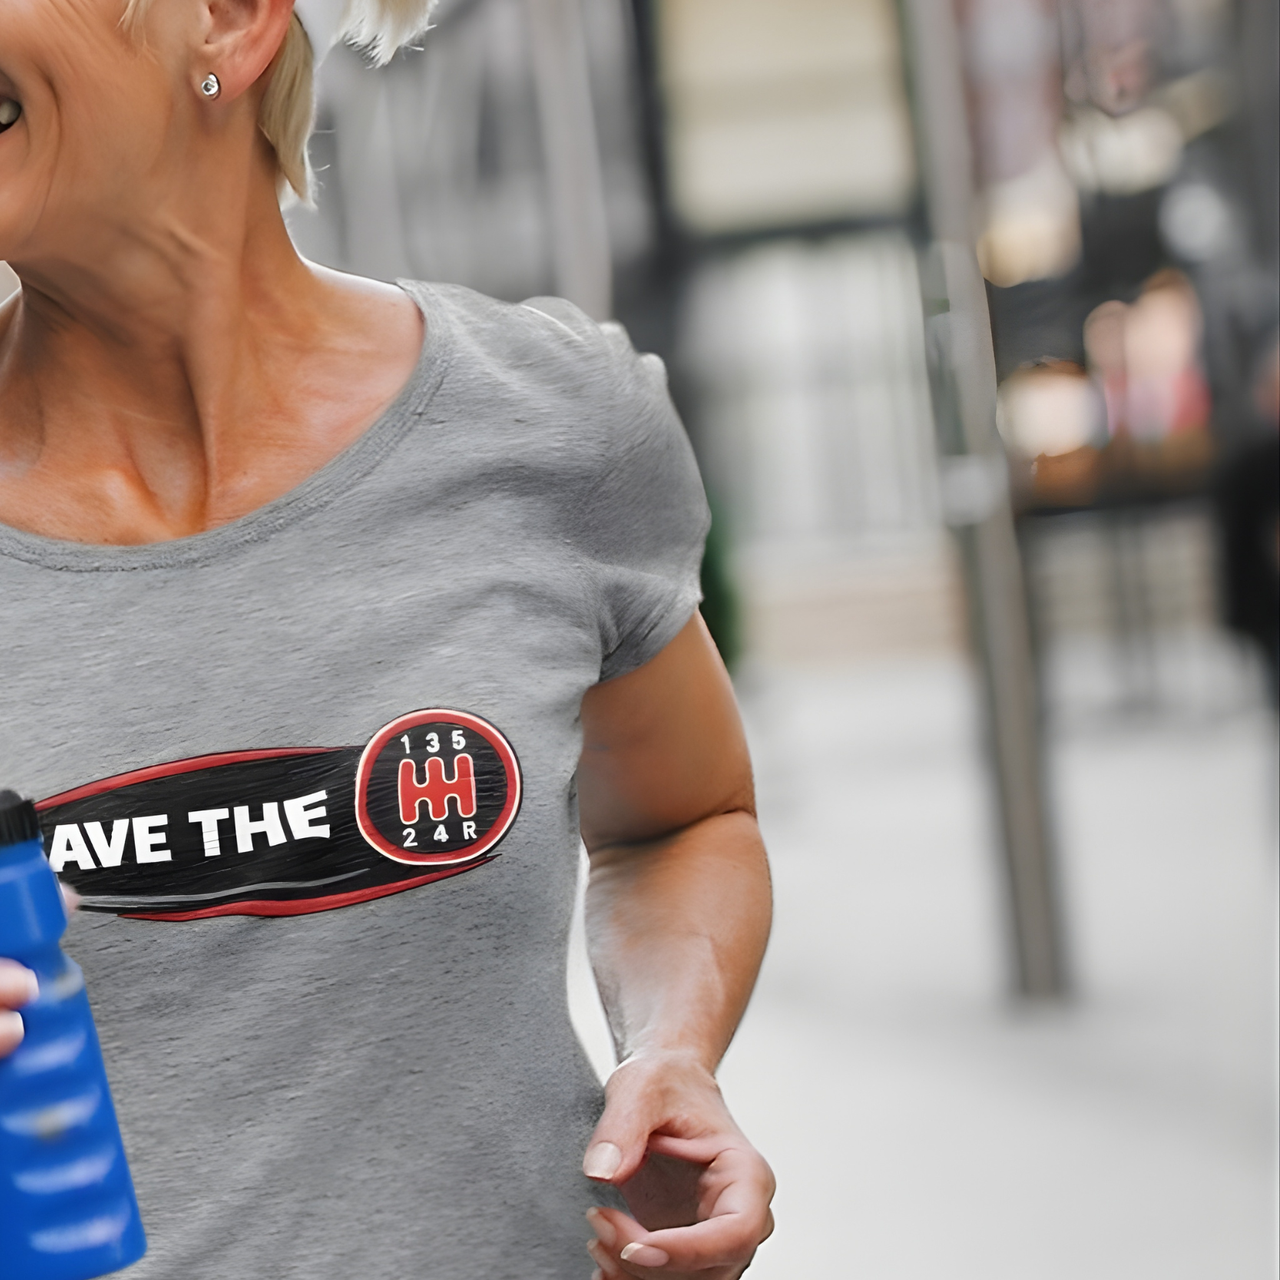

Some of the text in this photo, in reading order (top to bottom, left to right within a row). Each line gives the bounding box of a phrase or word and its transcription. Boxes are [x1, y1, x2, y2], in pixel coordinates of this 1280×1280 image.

[400, 729, 467, 755] 1 3 5
[48, 789, 331, 873] AVE THE
[402, 820, 478, 848] 2 4 R
